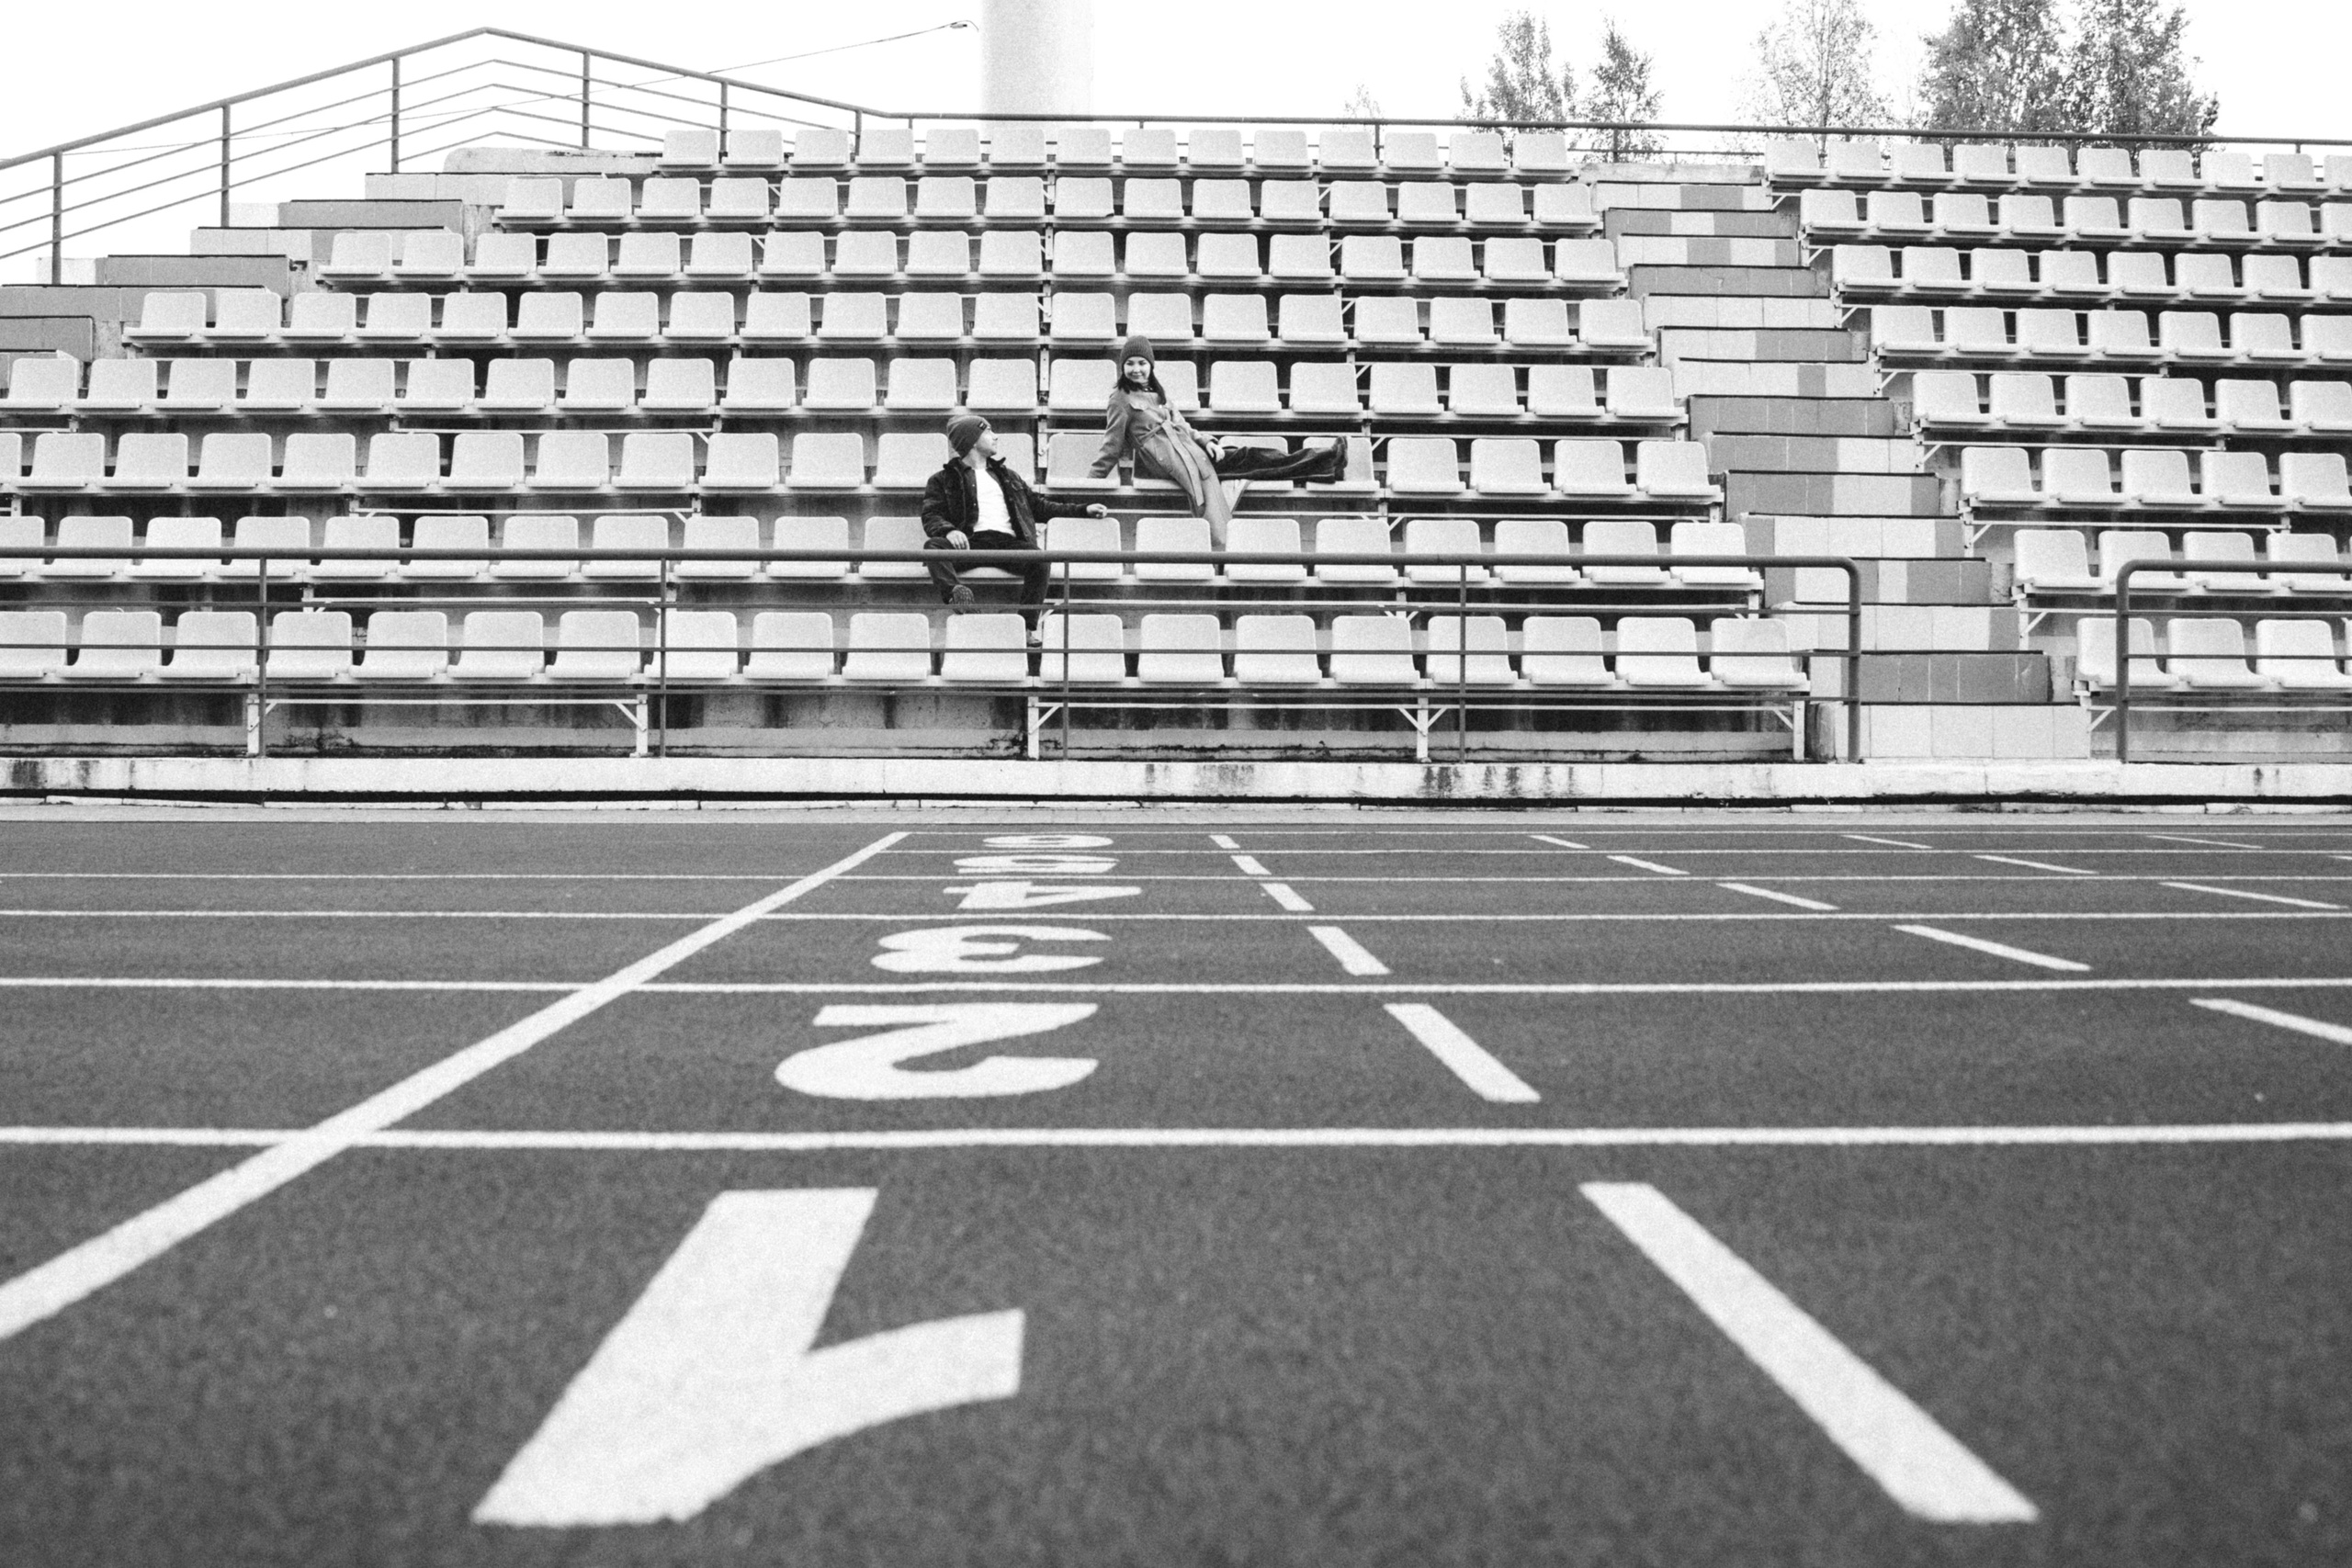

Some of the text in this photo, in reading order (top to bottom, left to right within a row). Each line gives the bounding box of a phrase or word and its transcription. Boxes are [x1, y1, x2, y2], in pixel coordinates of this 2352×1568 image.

[954, 854, 1119, 874] 5
[943, 881, 1142, 909] 4
[871, 925, 1112, 974] 3
[775, 1002, 1099, 1101] 2
[473, 1187, 1025, 1527] 1
